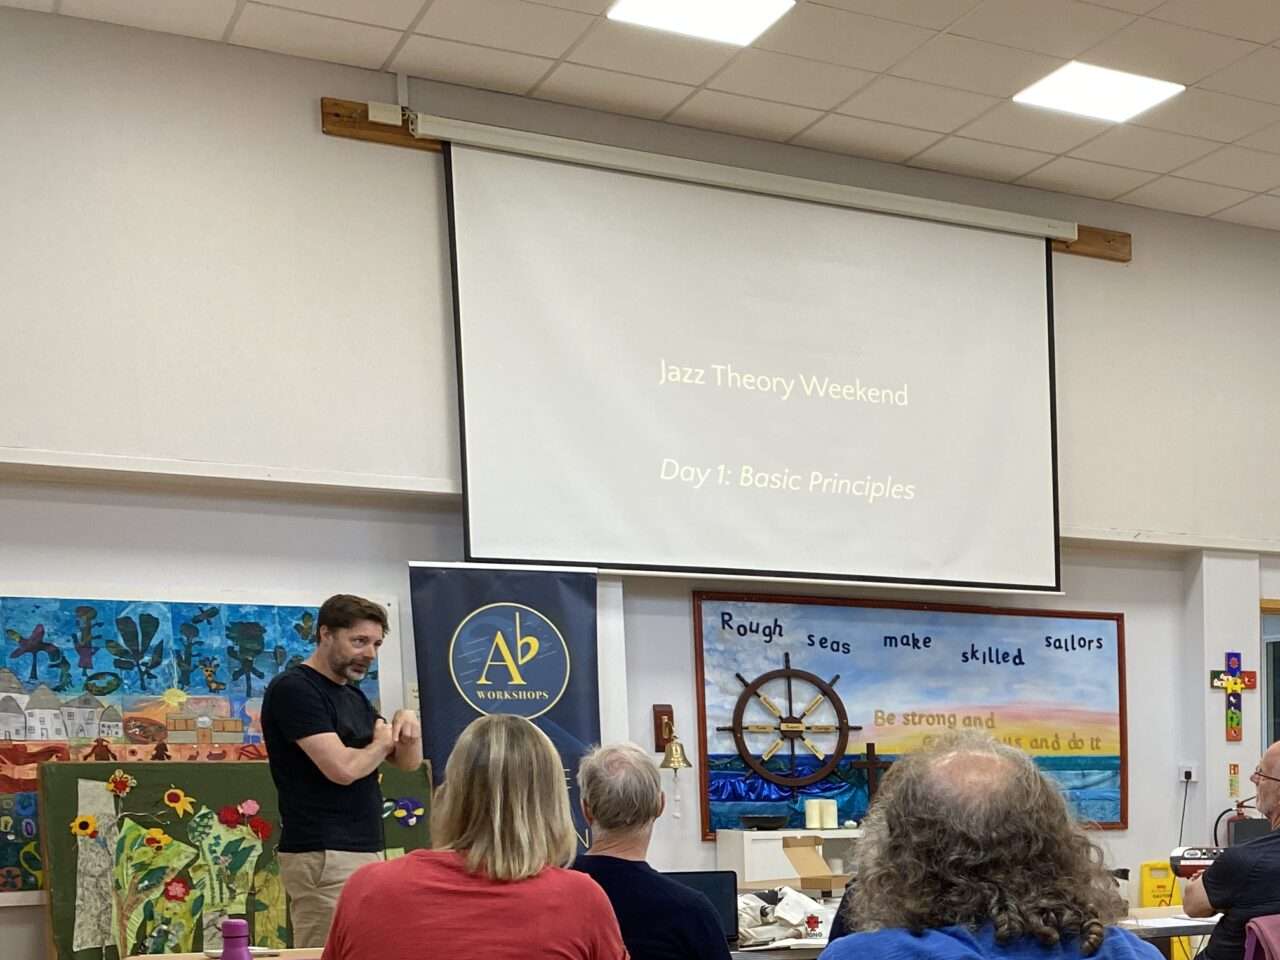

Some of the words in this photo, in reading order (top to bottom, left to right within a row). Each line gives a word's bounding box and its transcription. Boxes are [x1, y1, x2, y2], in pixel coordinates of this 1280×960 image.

[659, 359, 706, 385] Jazz
[711, 364, 795, 400] Theory
[799, 373, 909, 406] Weekend
[660, 458, 712, 489] Day
[716, 464, 732, 486] 1:
[740, 465, 802, 491] Basic
[808, 472, 916, 503] Principles
[720, 612, 784, 644] Rough
[807, 634, 851, 655] seas
[883, 633, 932, 650] make
[961, 643, 1025, 667] skilled
[1045, 635, 1104, 652] sailors
[476, 690, 549, 700] WORKSHOPS
[874, 710, 896, 726] Be
[902, 710, 957, 729] strong
[962, 711, 996, 729] and
[1030, 733, 1060, 751] and
[1068, 733, 1085, 750] do
[1090, 736, 1102, 751] it
